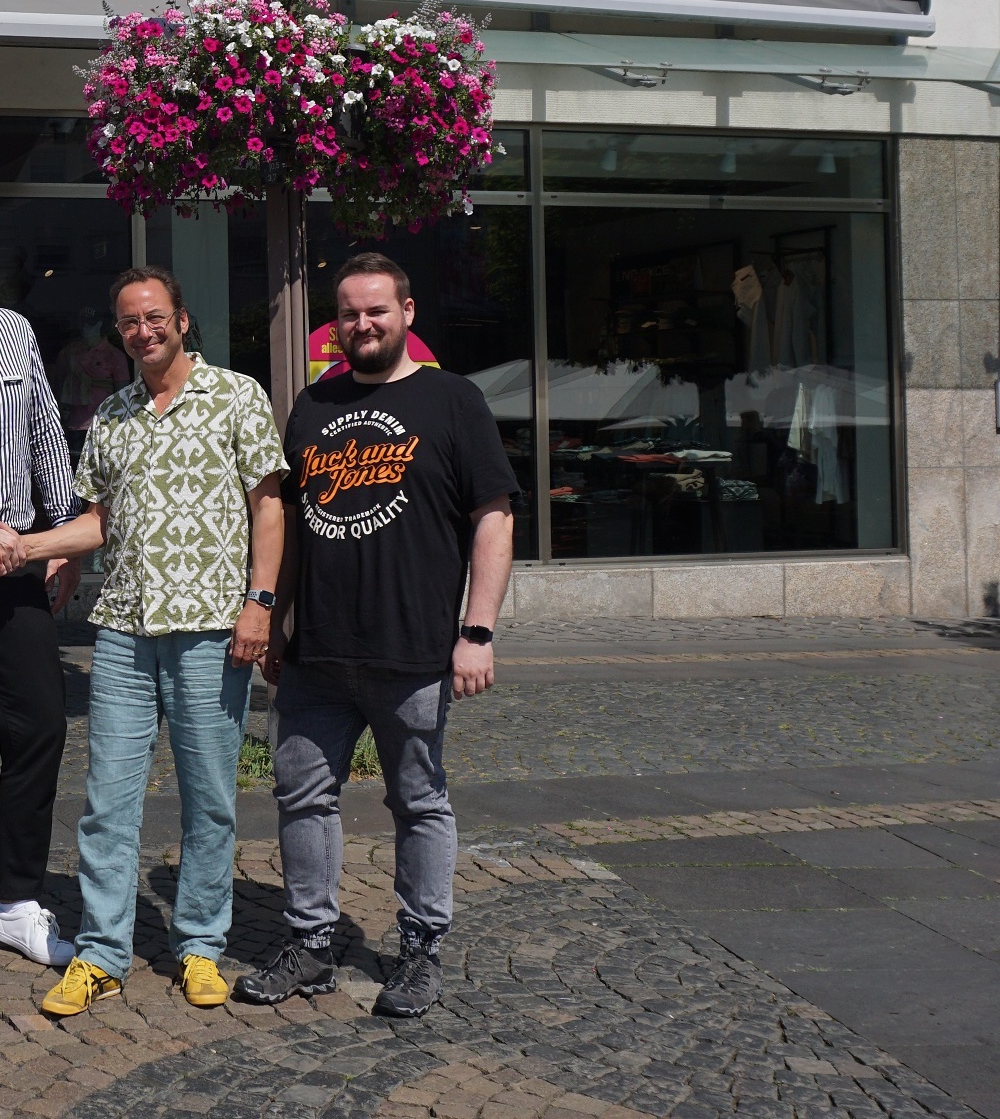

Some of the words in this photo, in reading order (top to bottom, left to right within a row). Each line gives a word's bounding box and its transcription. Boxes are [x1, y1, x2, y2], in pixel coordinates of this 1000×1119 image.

[321, 410, 368, 436] SUPPLY
[370, 410, 406, 436] DENIM
[329, 421, 362, 437] CERTIFIED
[363, 420, 393, 437] AUTHENTIC
[299, 438, 358, 488] Jack
[358, 435, 419, 465] and
[318, 462, 406, 505] Jones
[344, 503, 381, 522] TRADEMARK
[350, 489, 409, 539] QUALITY
